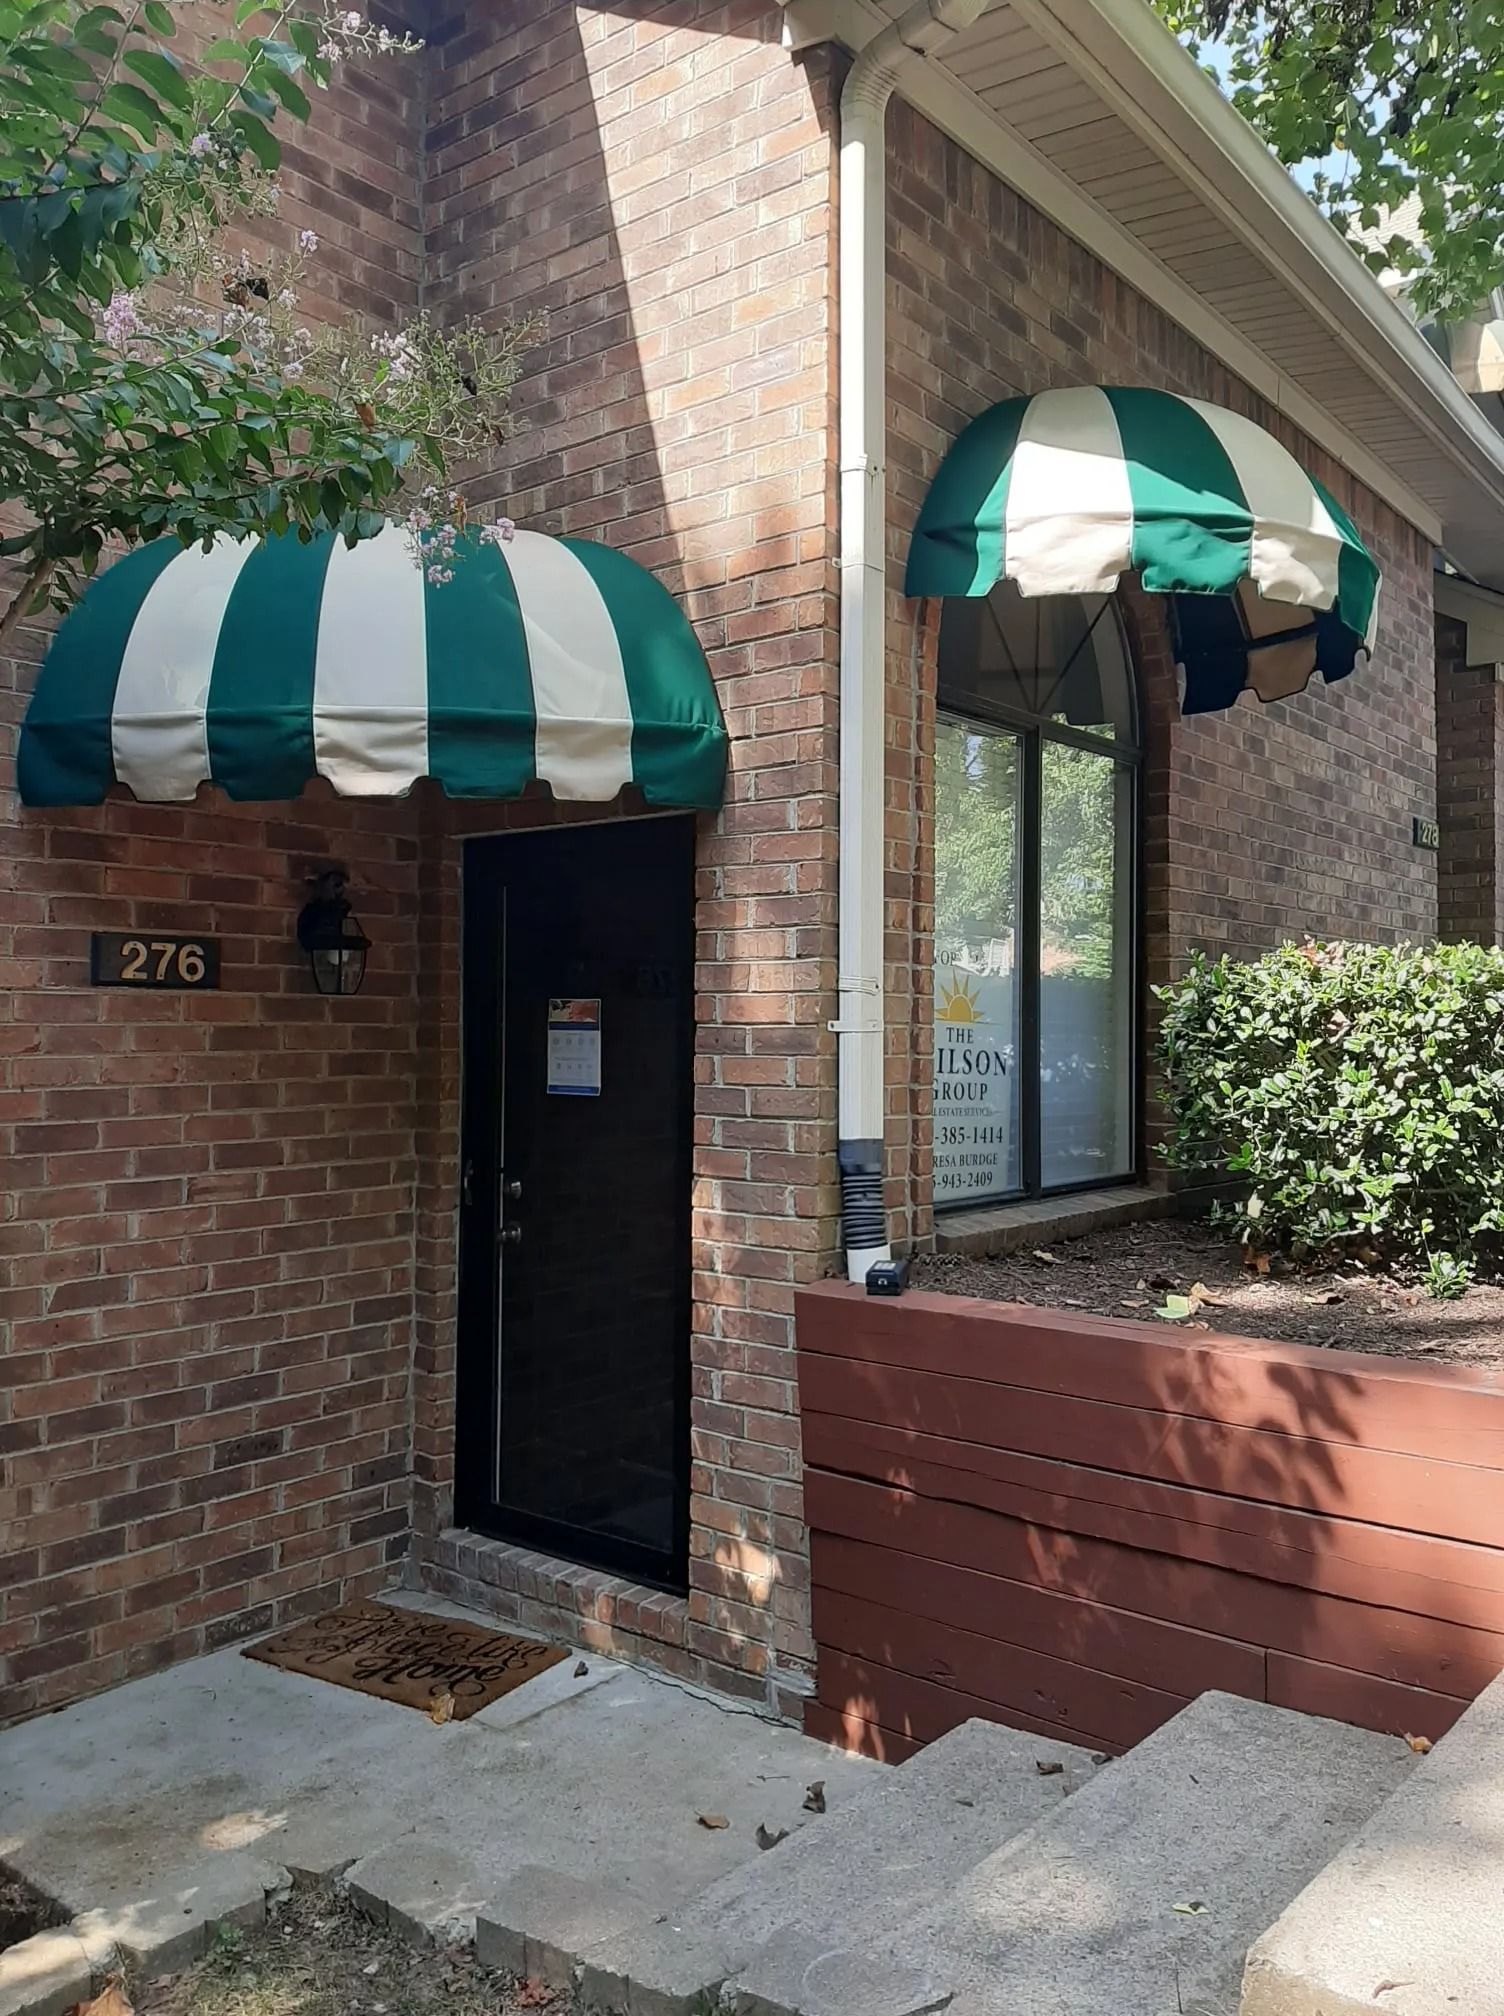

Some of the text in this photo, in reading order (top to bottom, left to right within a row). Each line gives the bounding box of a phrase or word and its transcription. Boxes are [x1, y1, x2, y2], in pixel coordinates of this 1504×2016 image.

[1421, 822, 1440, 847] 278
[121, 941, 205, 982] 276
[946, 1027, 974, 1044] THE
[936, 1047, 1007, 1076] ILSON
[934, 1126, 1004, 1145] -385-1414
[932, 1152, 999, 1168] RESA BURDGE
[932, 1171, 993, 1189] 5-943-2409
